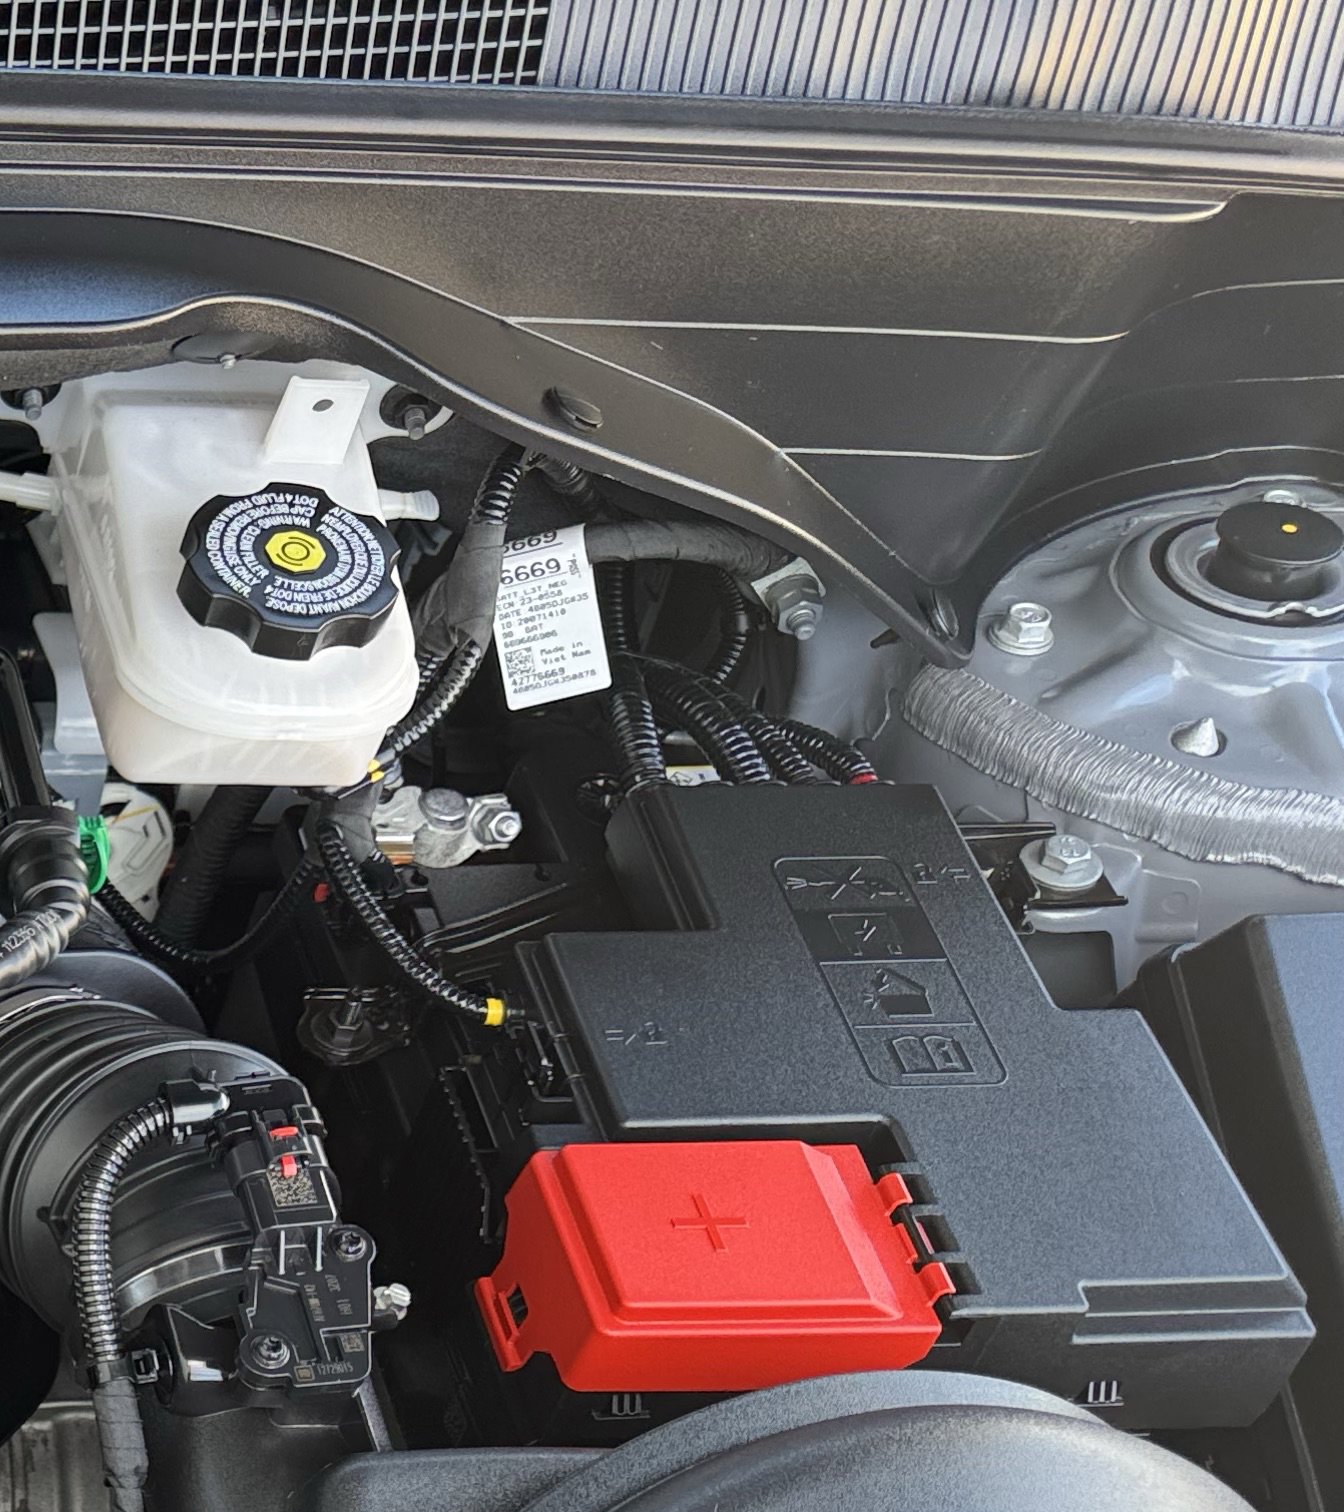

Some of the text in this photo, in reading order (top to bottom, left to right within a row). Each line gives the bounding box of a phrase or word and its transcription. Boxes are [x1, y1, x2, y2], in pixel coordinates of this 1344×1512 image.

[247, 492, 285, 506] FLUID
[284, 492, 294, 503] 4
[292, 494, 319, 508] DOT
[221, 498, 254, 518] FROM
[245, 503, 290, 520] BEFORE
[289, 502, 316, 517] CAP
[205, 519, 226, 551] SEALED
[504, 530, 558, 553] 669
[240, 551, 270, 579] FILLER
[233, 565, 262, 586] ONLY
[263, 584, 275, 594] 4
[270, 587, 293, 601] DOT
[320, 589, 338, 601] DE
[293, 592, 324, 604] FREIN
[308, 601, 341, 615] AVANT
[540, 646, 565, 656] Made
[540, 648, 591, 665] Viet Nam
